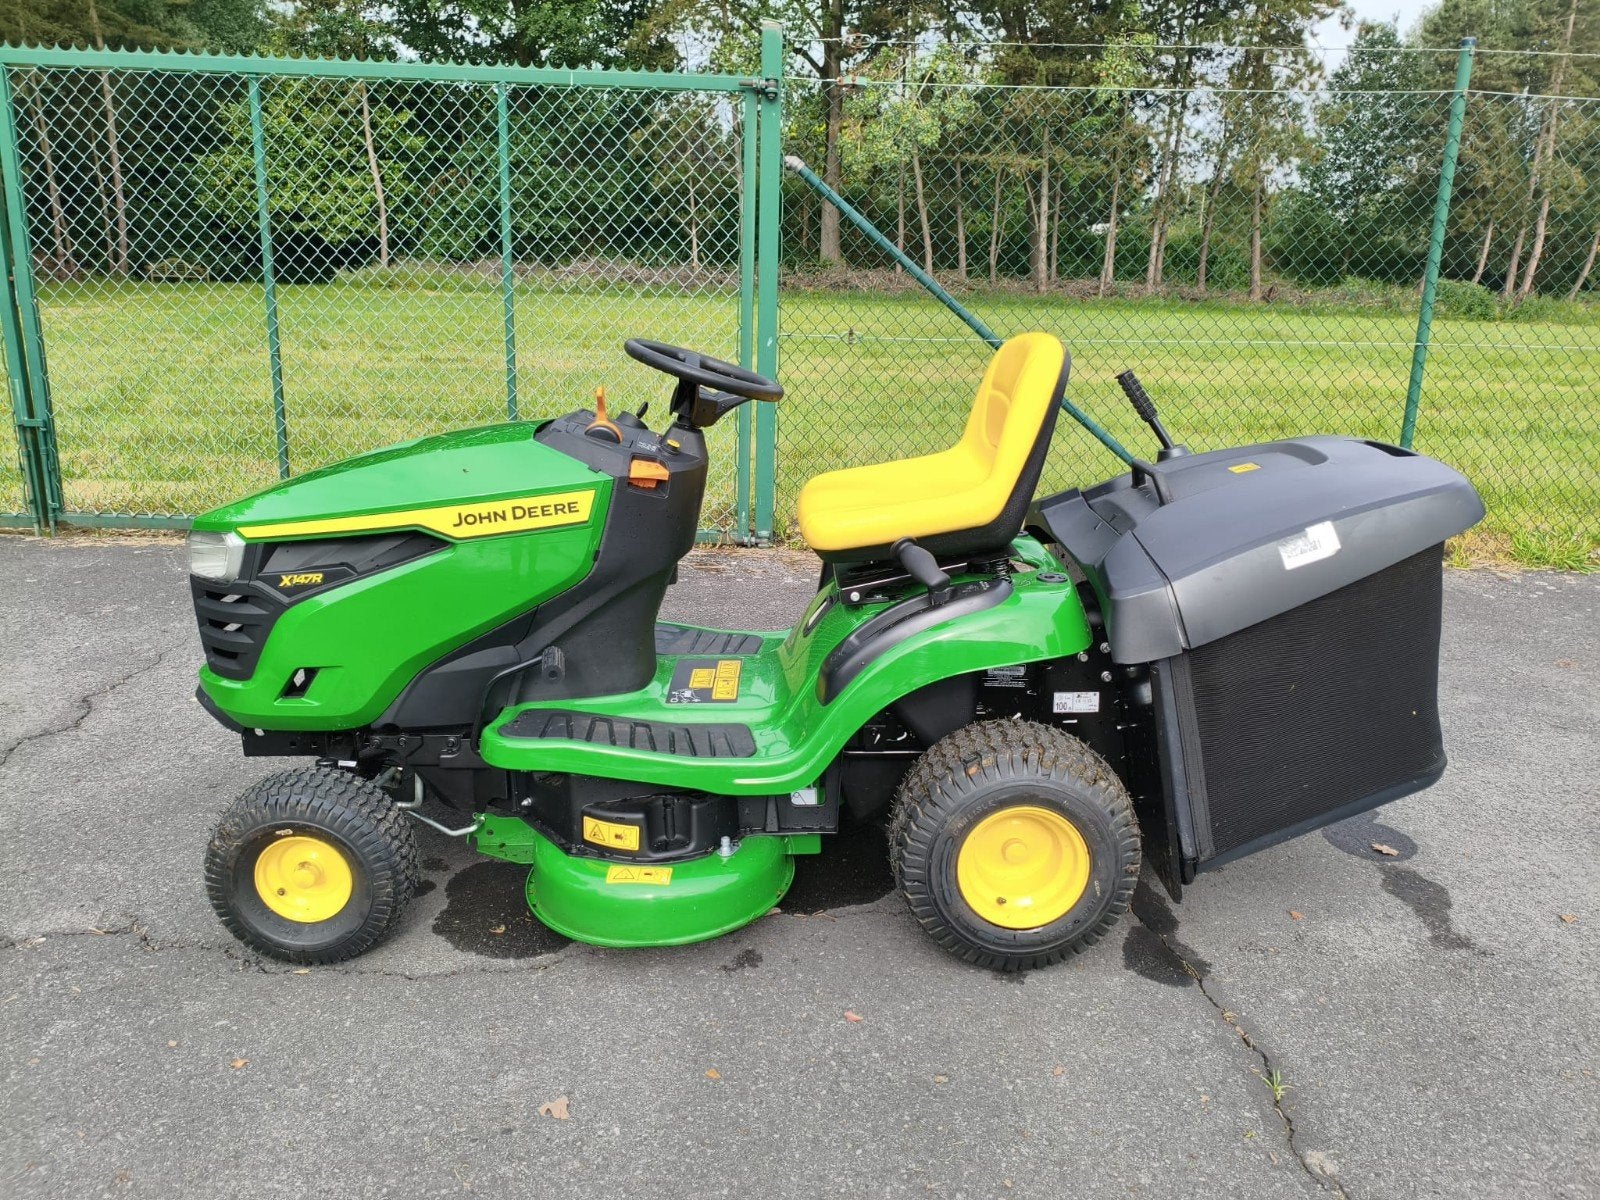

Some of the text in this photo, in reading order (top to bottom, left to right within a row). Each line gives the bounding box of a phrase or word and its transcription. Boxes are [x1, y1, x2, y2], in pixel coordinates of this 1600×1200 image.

[453, 501, 580, 527] JOHN DEERE
[279, 573, 323, 587] X147R
[1056, 701, 1068, 711] 100
